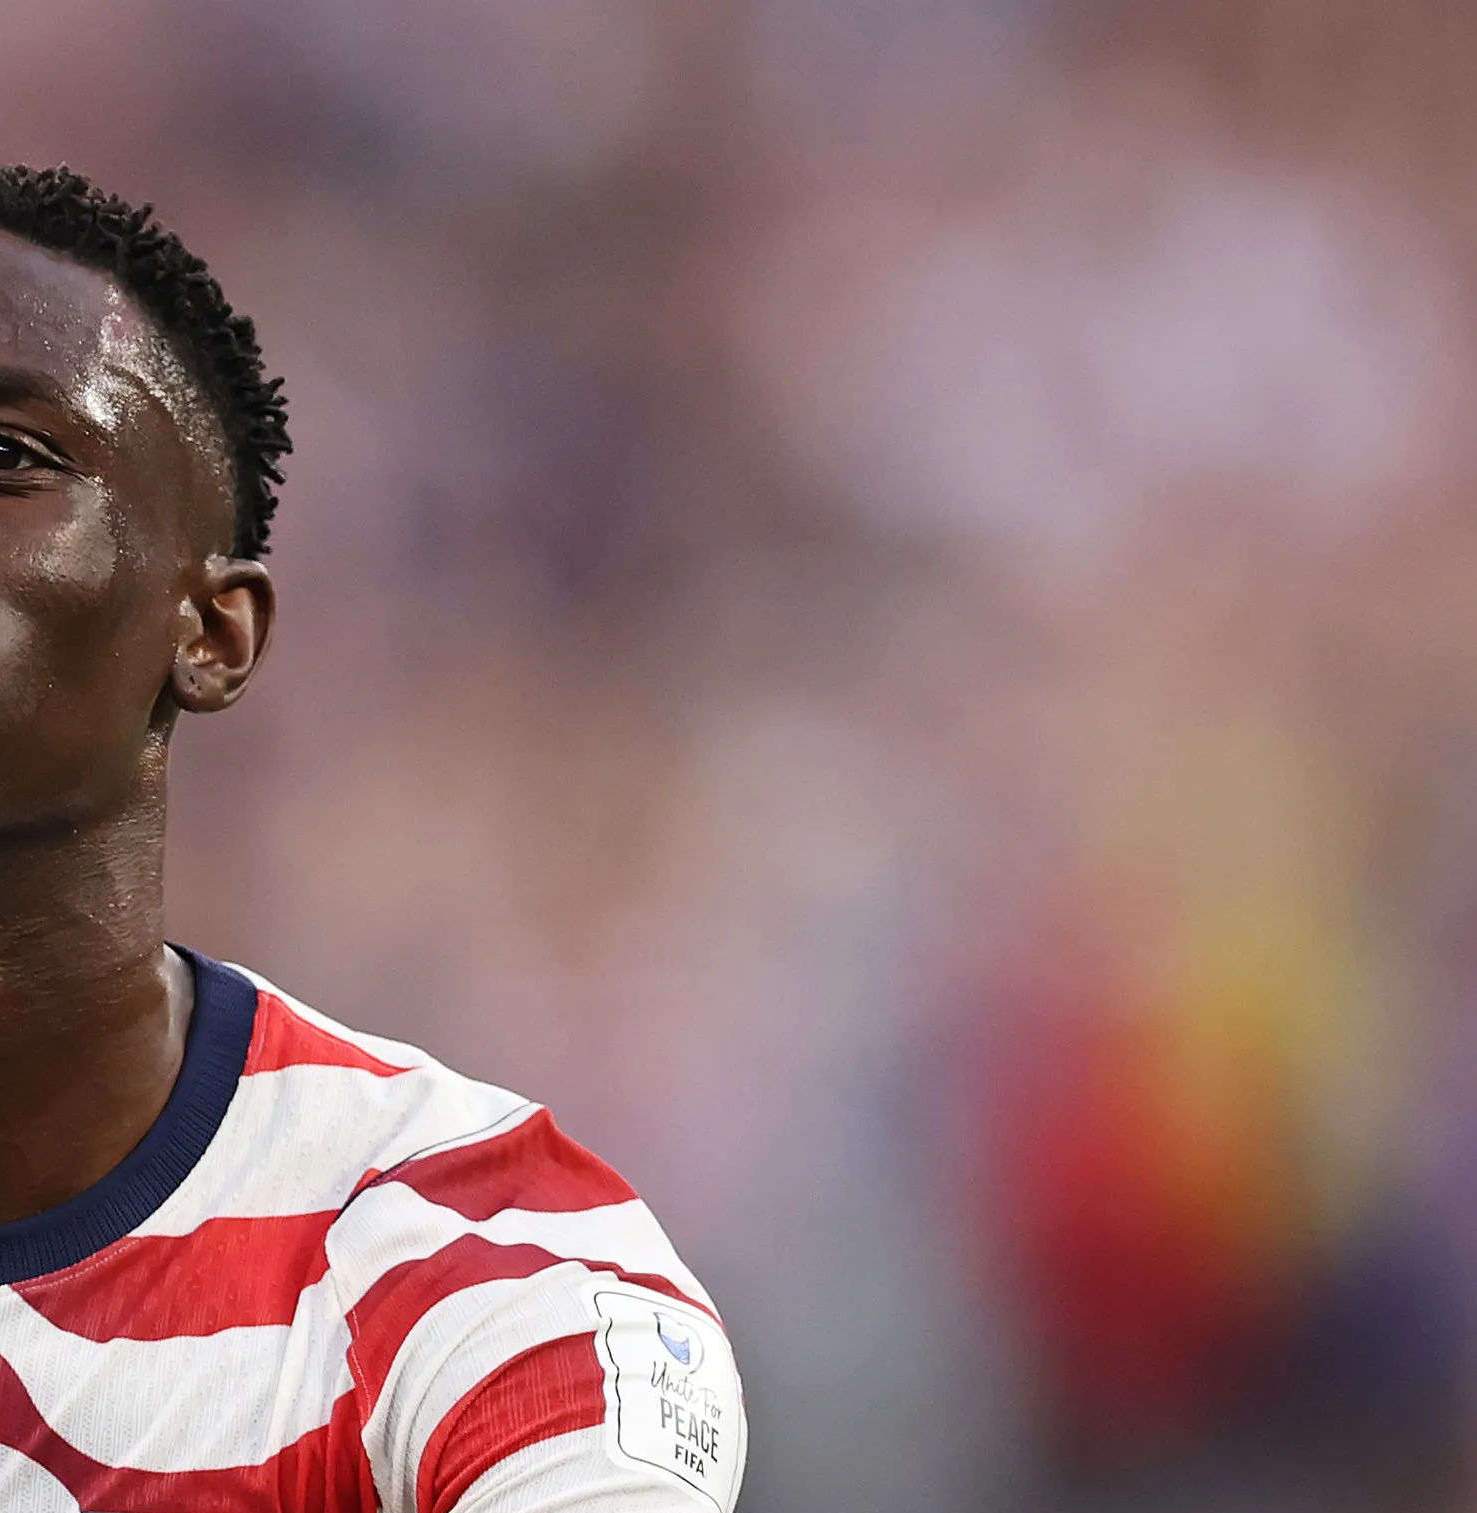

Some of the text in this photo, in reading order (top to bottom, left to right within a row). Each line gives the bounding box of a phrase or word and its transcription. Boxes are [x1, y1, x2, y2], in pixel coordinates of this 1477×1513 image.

[650, 1360, 723, 1421] Unite For
[659, 1396, 720, 1464] PEACE
[674, 1443, 706, 1478] FIFA
